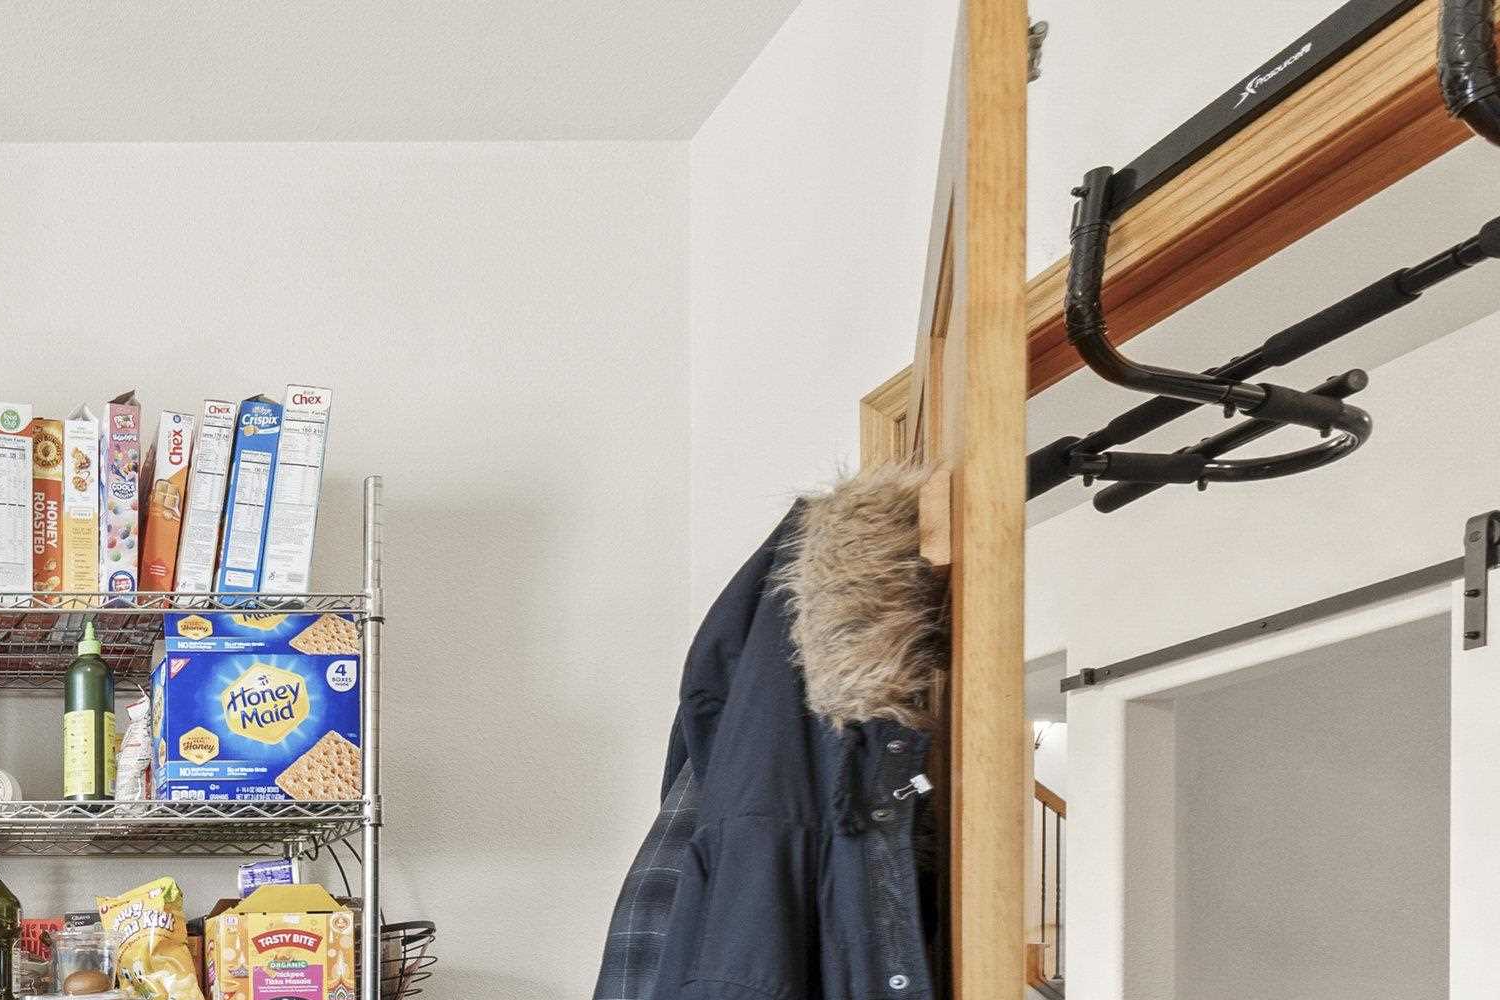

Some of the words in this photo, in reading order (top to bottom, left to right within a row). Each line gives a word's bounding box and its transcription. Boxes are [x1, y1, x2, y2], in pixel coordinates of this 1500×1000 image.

[292, 393, 322, 405] Chex
[208, 405, 231, 415] Chex
[241, 413, 279, 426] Crispix
[169, 429, 183, 466] Chex
[33, 492, 45, 554] ROASTED
[46, 501, 58, 549] HONEY
[334, 664, 347, 676] 4
[227, 682, 301, 712] Honey
[240, 703, 295, 730] Maid
[182, 741, 215, 754] Honey
[257, 934, 290, 948] TASTY
[293, 934, 316, 947] BITE
[269, 960, 307, 969] ORGANIC
